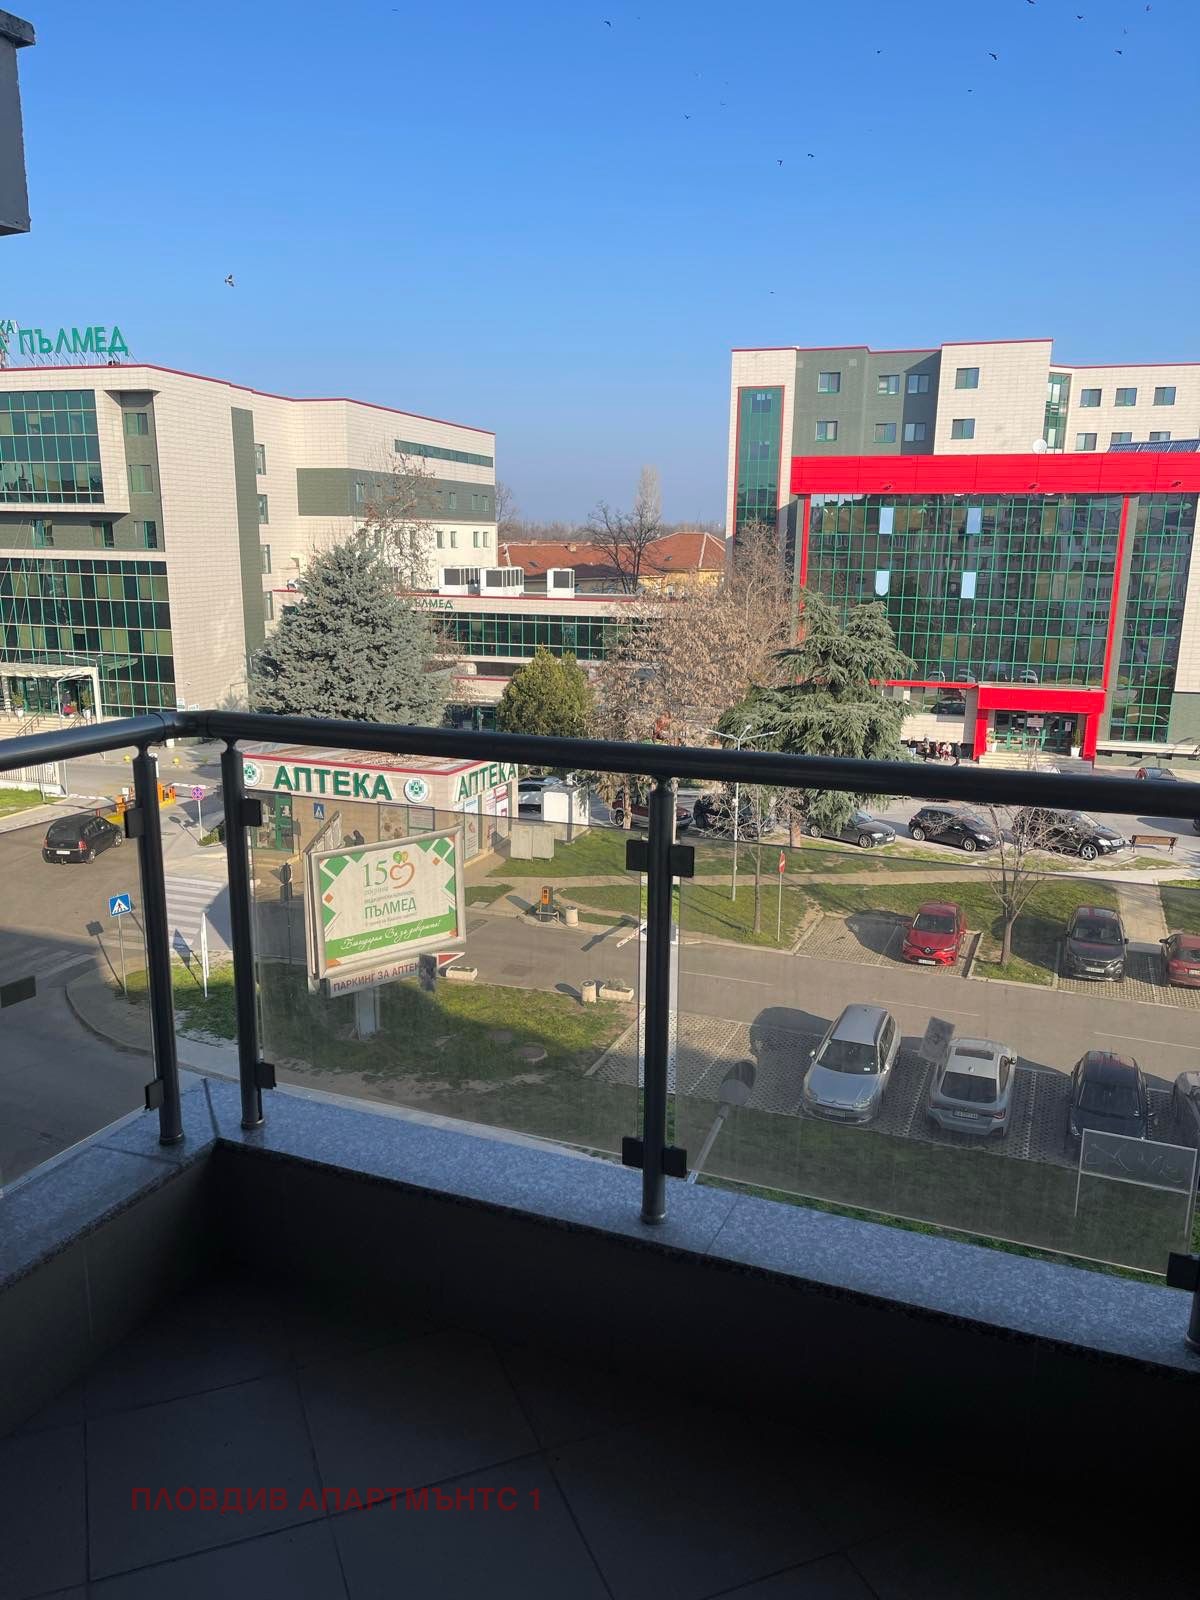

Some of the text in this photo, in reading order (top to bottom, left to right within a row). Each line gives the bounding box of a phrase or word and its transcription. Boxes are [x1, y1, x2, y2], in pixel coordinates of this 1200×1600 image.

[19, 326, 129, 357] ПЪЛМЕД
[273, 765, 393, 801] АПТЕКА
[458, 763, 517, 802] АПТЕКА
[362, 860, 388, 887] 15
[364, 897, 417, 919] ПЪЛМЕД
[333, 962, 418, 992] ПАРКИНГ ЗА АПТЕ
